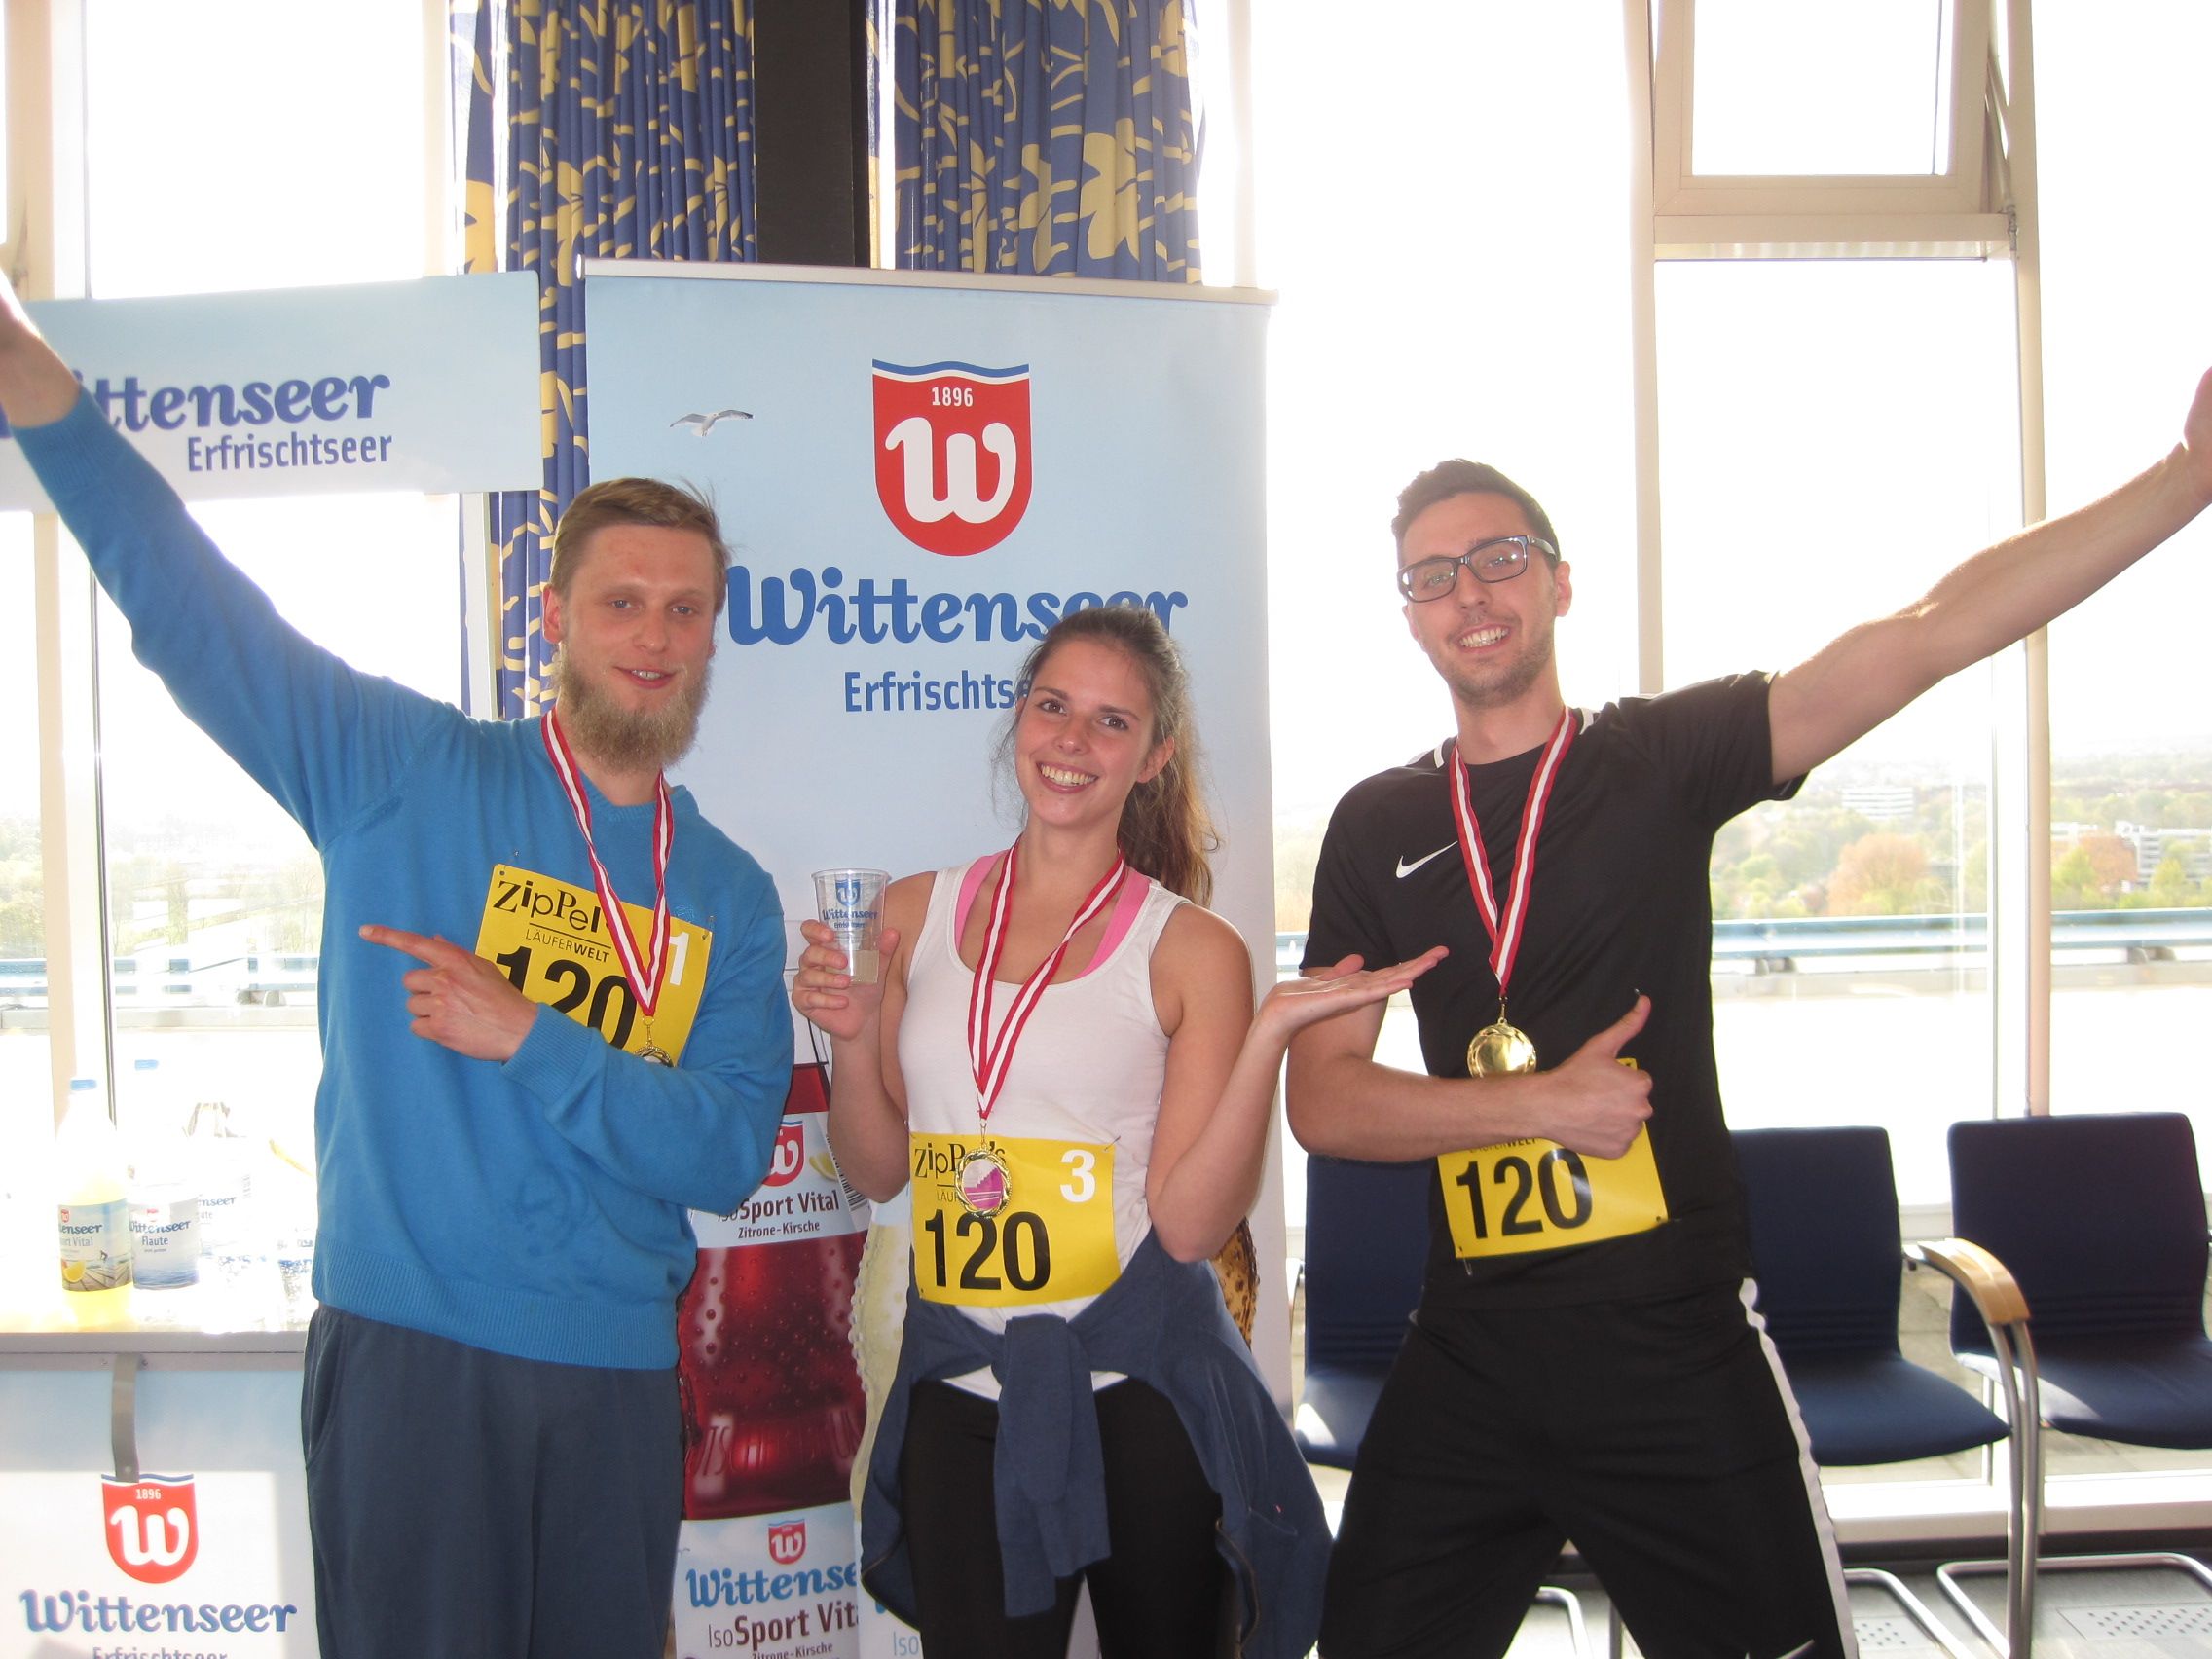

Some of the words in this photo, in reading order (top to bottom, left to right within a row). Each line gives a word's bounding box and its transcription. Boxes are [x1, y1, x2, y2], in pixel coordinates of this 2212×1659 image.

[0, 369, 390, 438] ttenseer
[932, 387, 974, 408] 1896
[188, 430, 392, 471] Erfrischtseer
[844, 671, 1028, 713] Erfrischts
[526, 928, 610, 963] LÄUFERWELT
[669, 932, 689, 986] 1
[496, 946, 637, 1050] 120
[1060, 1149, 1096, 1203] 3
[1456, 1148, 1593, 1239] 120
[797, 1190, 840, 1213] Vital
[73, 1236, 93, 1247] Vital
[141, 1235, 169, 1246] Flaute
[738, 1220, 821, 1238] Zitrone-Kirsche
[925, 1209, 1051, 1291] 120
[135, 1488, 162, 1500] 1896
[19, 1589, 298, 1633] Wittenseer
[708, 1609, 810, 1651] IsoSport
